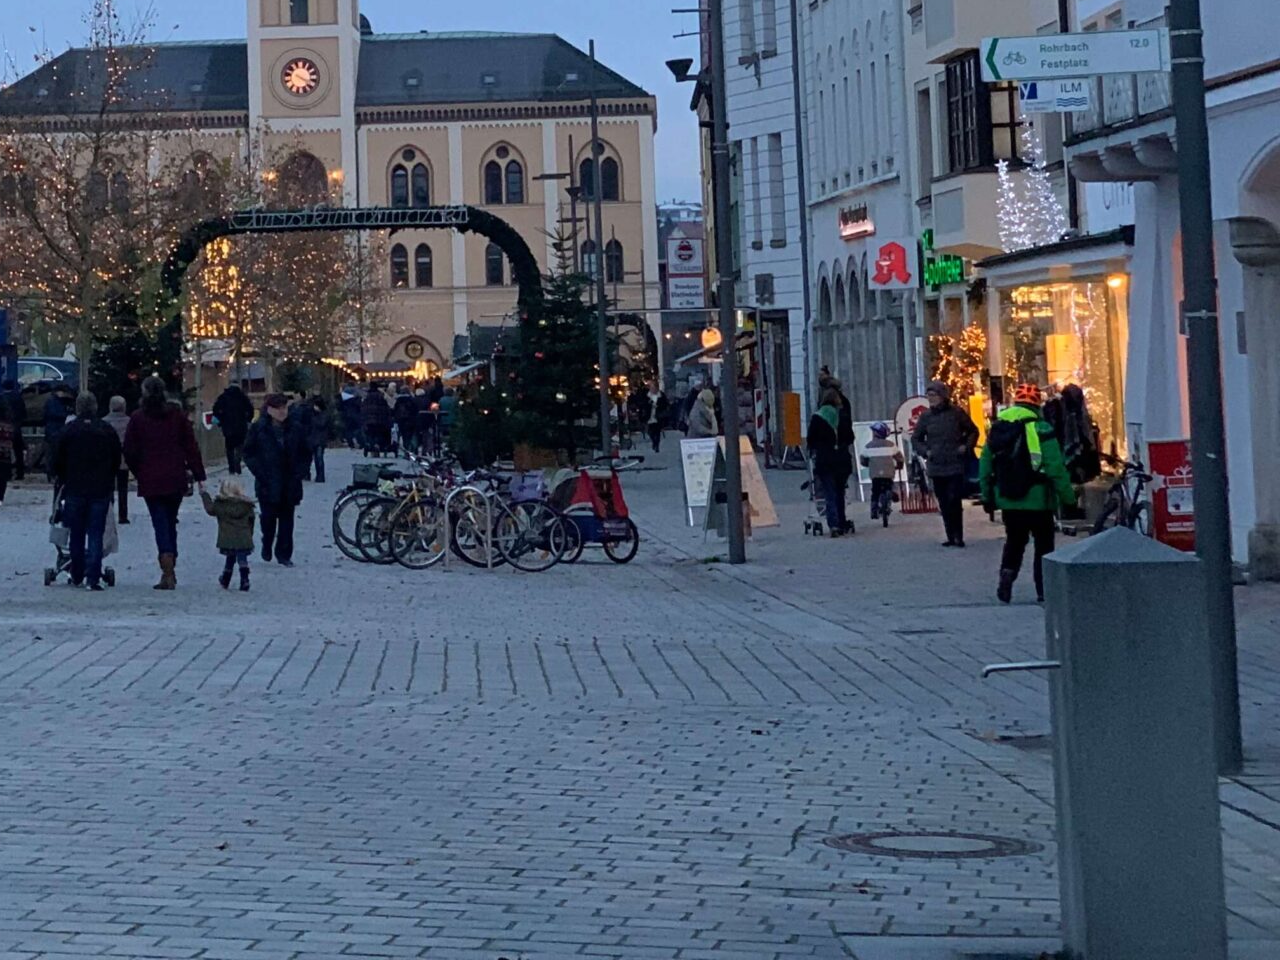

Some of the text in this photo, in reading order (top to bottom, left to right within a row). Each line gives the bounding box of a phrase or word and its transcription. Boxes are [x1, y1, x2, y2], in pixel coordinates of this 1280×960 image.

[1039, 38, 1149, 53] Rohrbach 12.0
[1040, 58, 1089, 70] Festplatz
[1060, 82, 1082, 94] ILM
[924, 254, 964, 292] Apotheke
